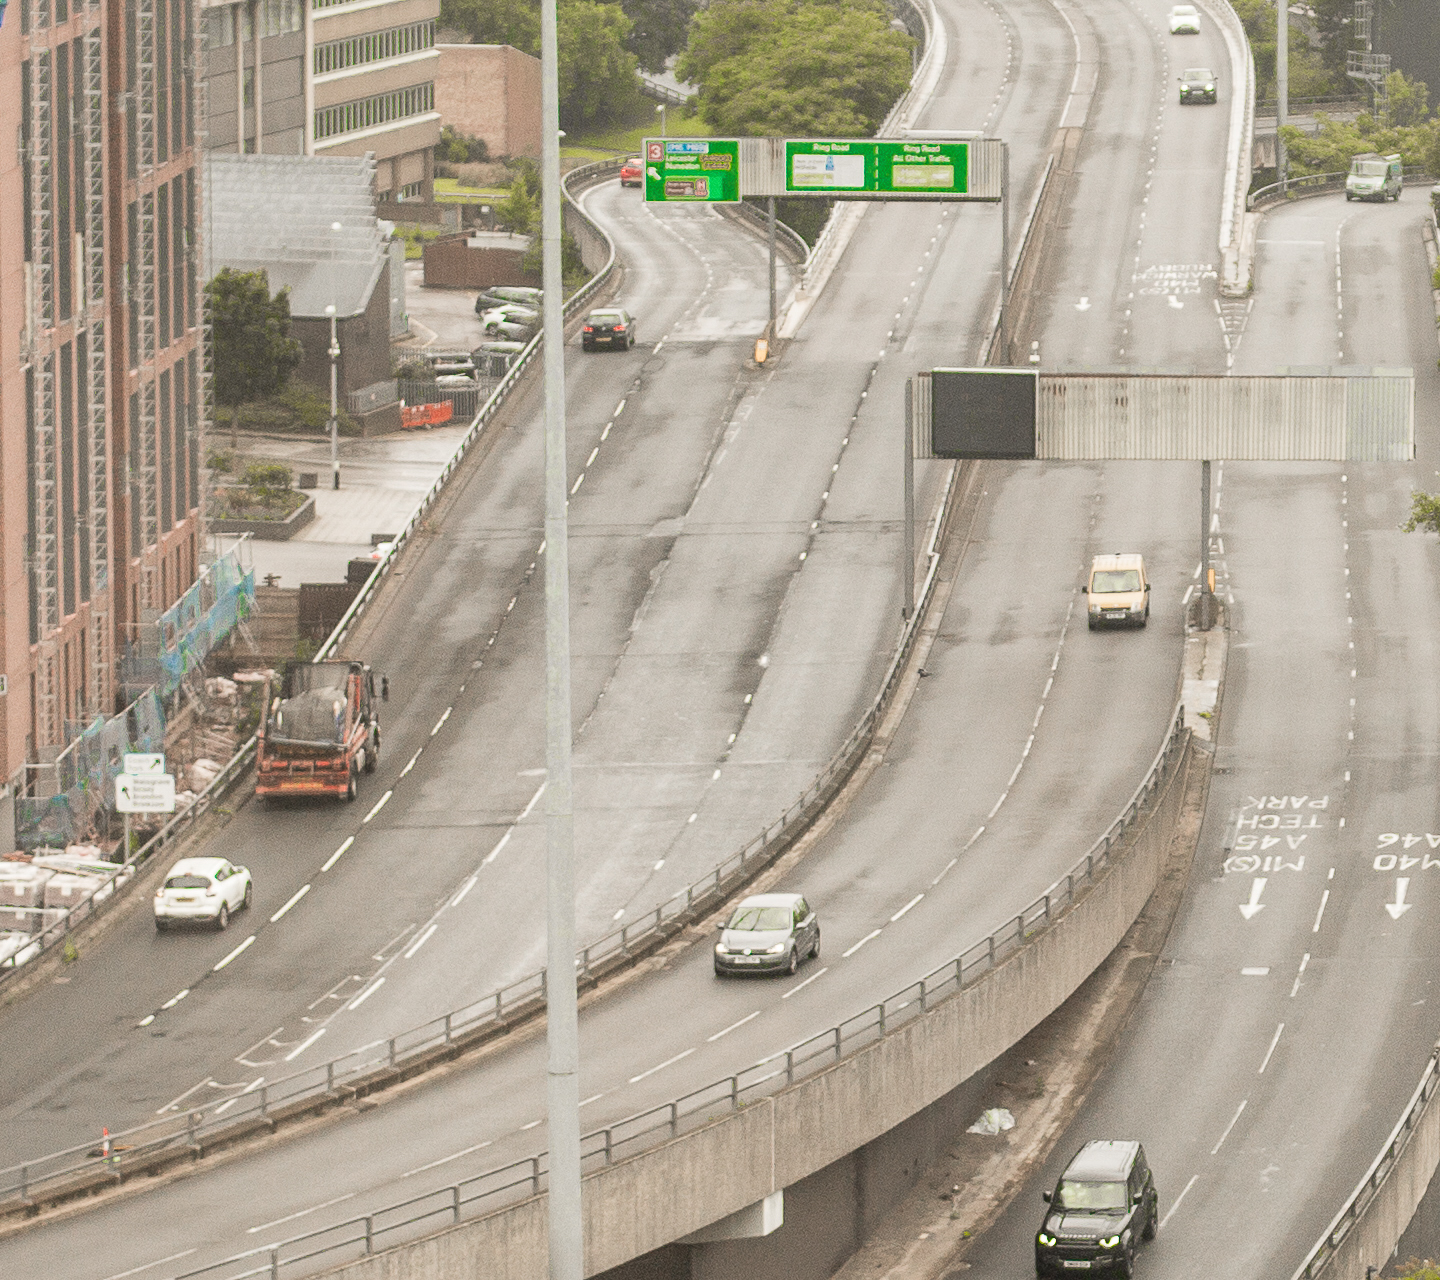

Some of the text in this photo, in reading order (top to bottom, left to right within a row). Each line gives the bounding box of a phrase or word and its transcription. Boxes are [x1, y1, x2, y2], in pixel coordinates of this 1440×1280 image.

[650, 144, 661, 159] 3
[1243, 795, 1329, 809] PARK
[1237, 814, 1324, 828] TECH
[1235, 834, 1308, 850] A45
[1224, 855, 1305, 873] M1(S)
